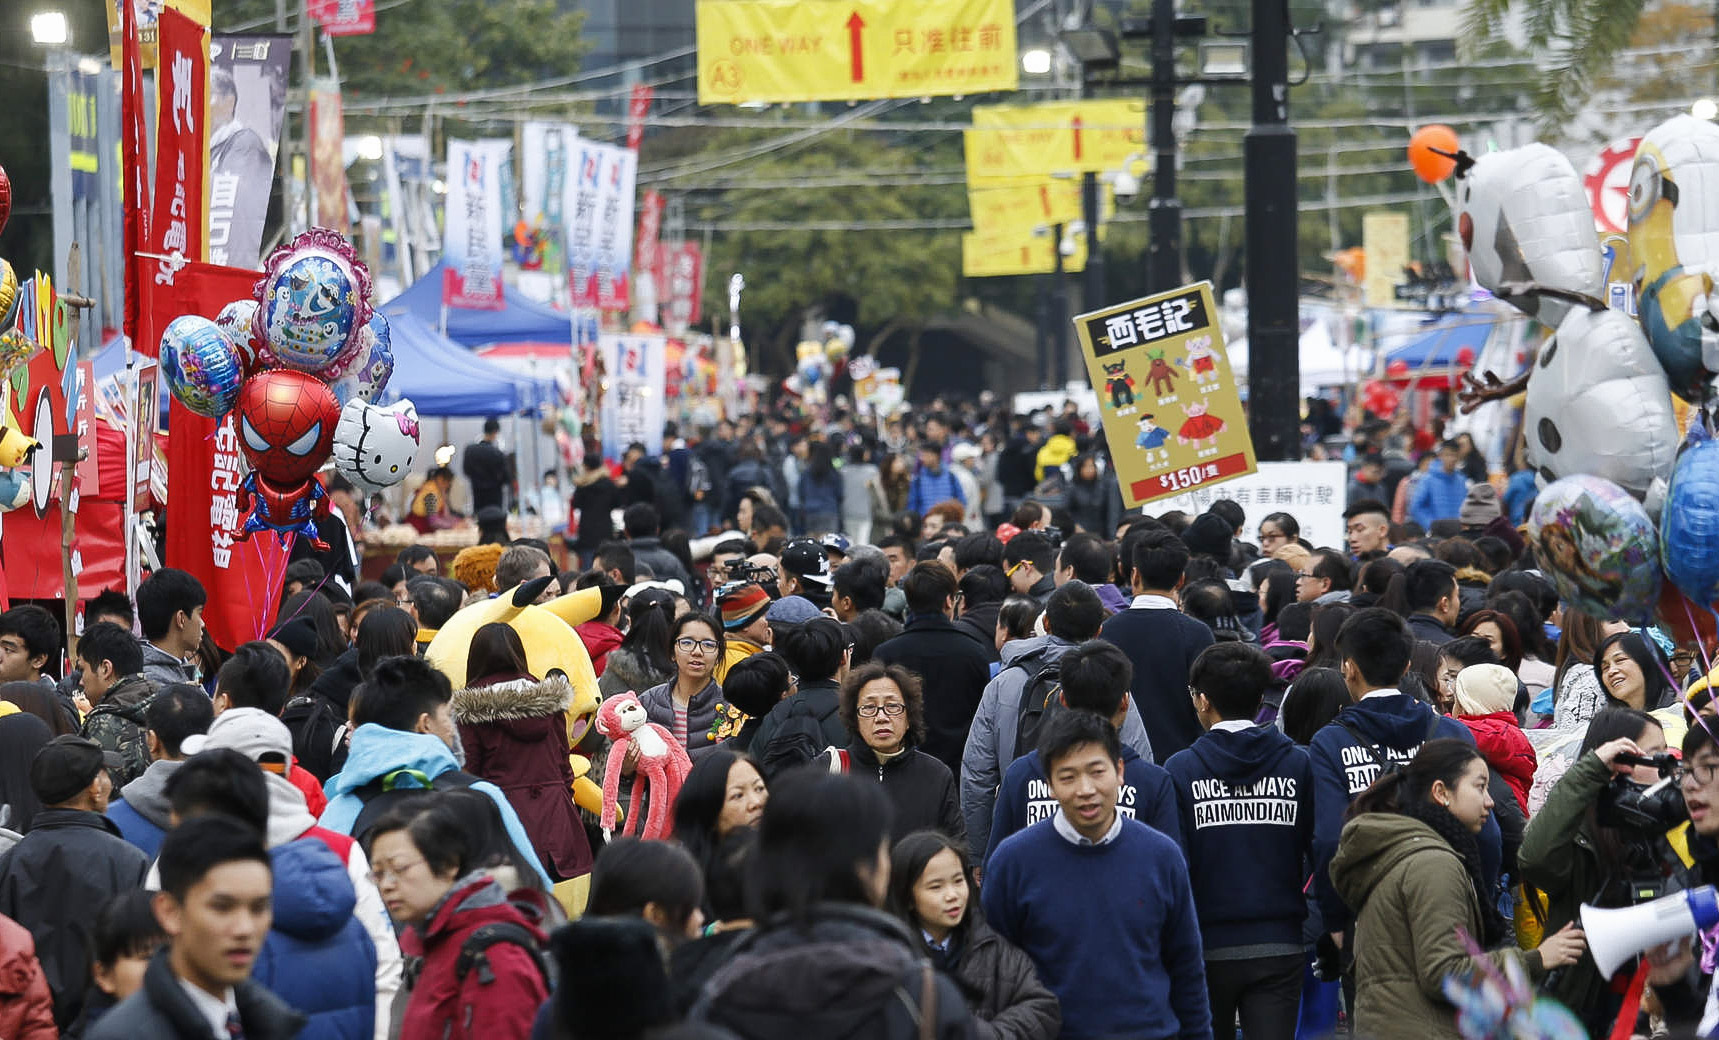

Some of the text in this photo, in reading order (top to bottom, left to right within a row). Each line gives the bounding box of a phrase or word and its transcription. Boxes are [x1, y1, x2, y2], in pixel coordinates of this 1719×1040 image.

[731, 34, 823, 56] ONE WAY
[711, 65, 742, 89] A3
[1105, 298, 1194, 349] 西毛記
[1028, 779, 1051, 799] ON
[1191, 776, 1297, 800] ONCE ALWAYS
[1195, 801, 1296, 828] RAIMONDIAN
